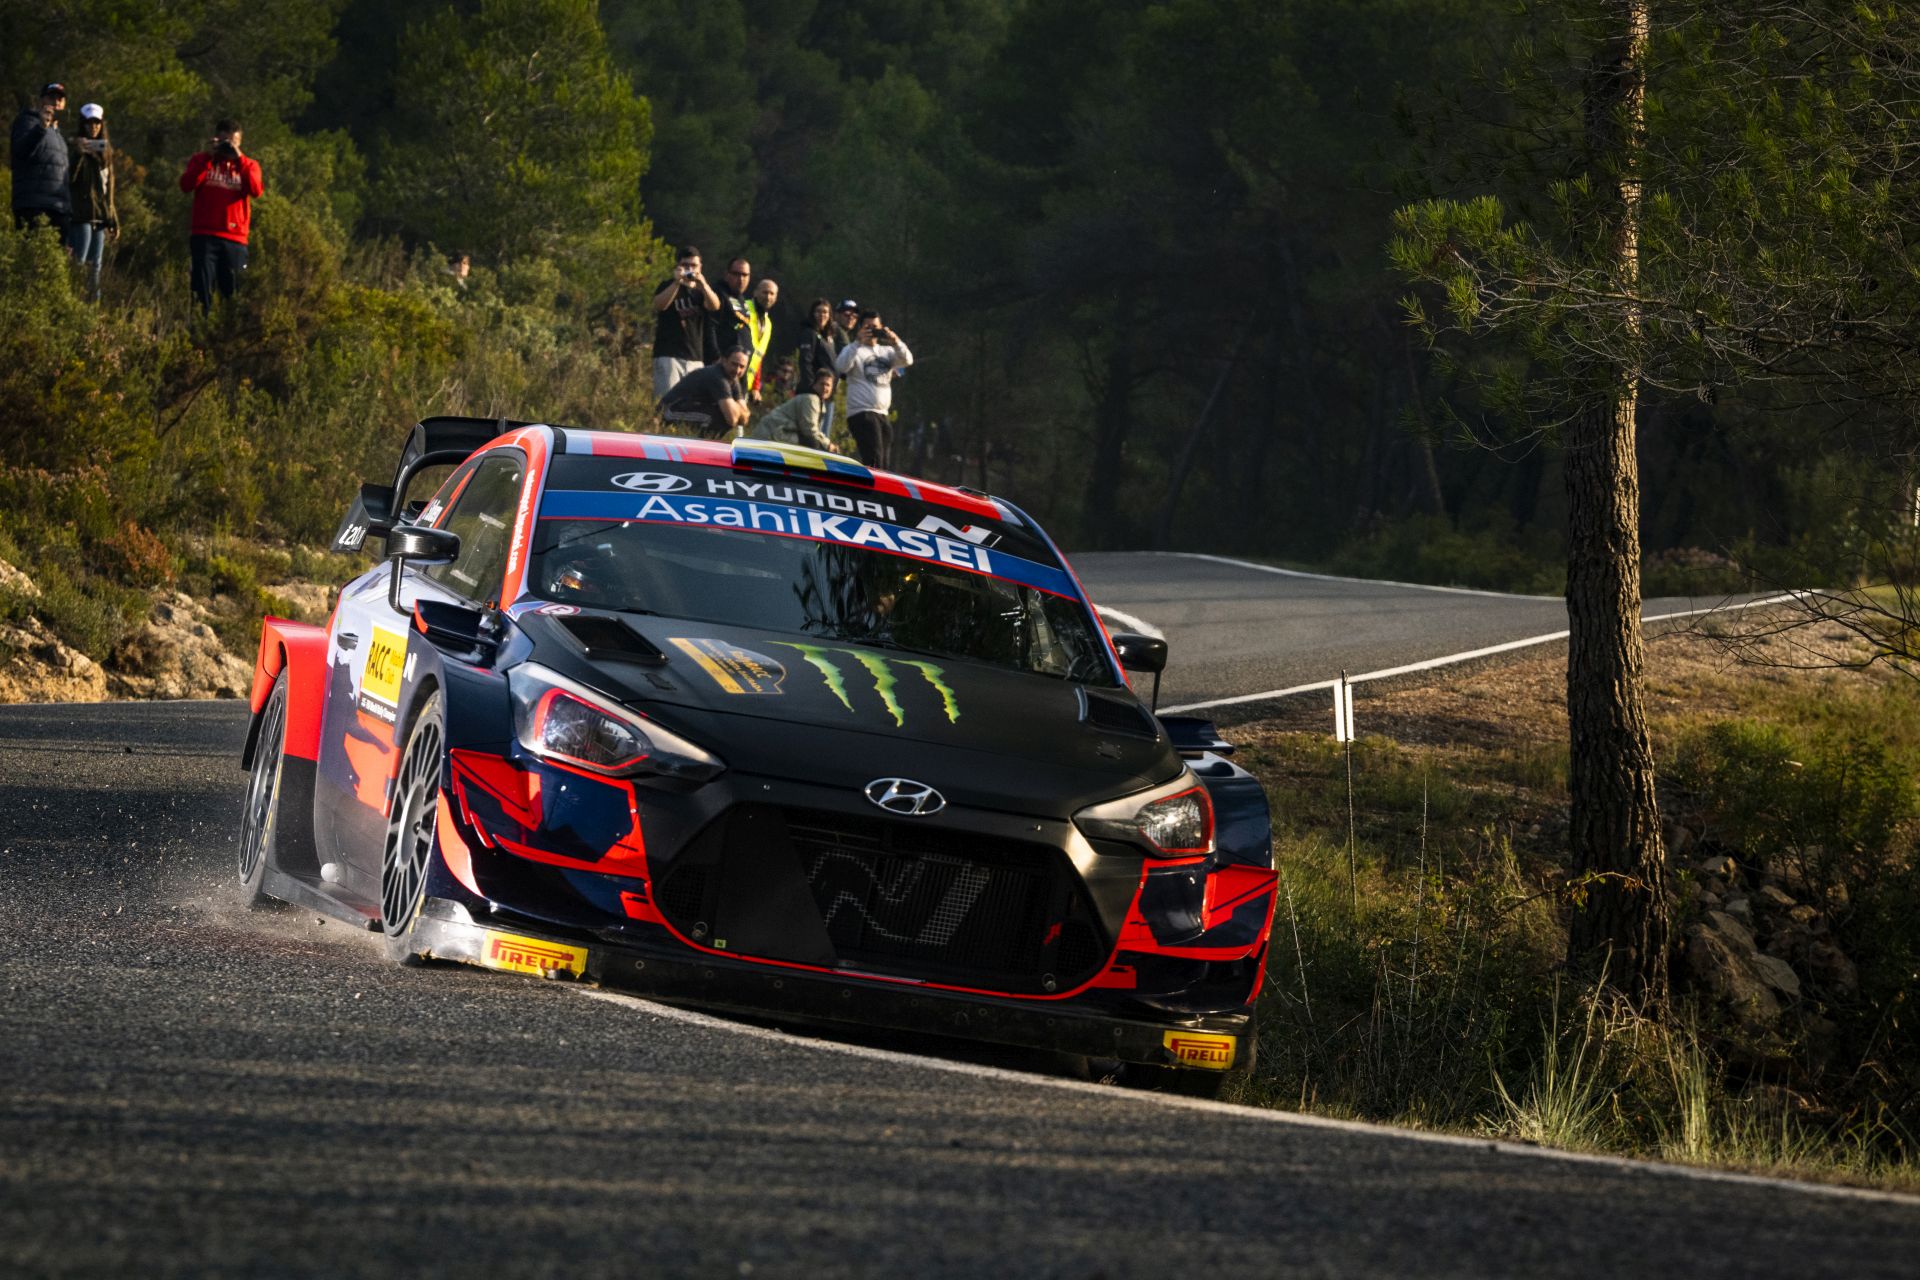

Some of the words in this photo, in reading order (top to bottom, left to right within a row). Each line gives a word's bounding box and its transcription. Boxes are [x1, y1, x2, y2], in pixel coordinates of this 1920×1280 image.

[706, 478, 897, 522] HYUNDAI
[365, 641, 391, 681] RACC
[1170, 1038, 1230, 1063] PIRELLI
